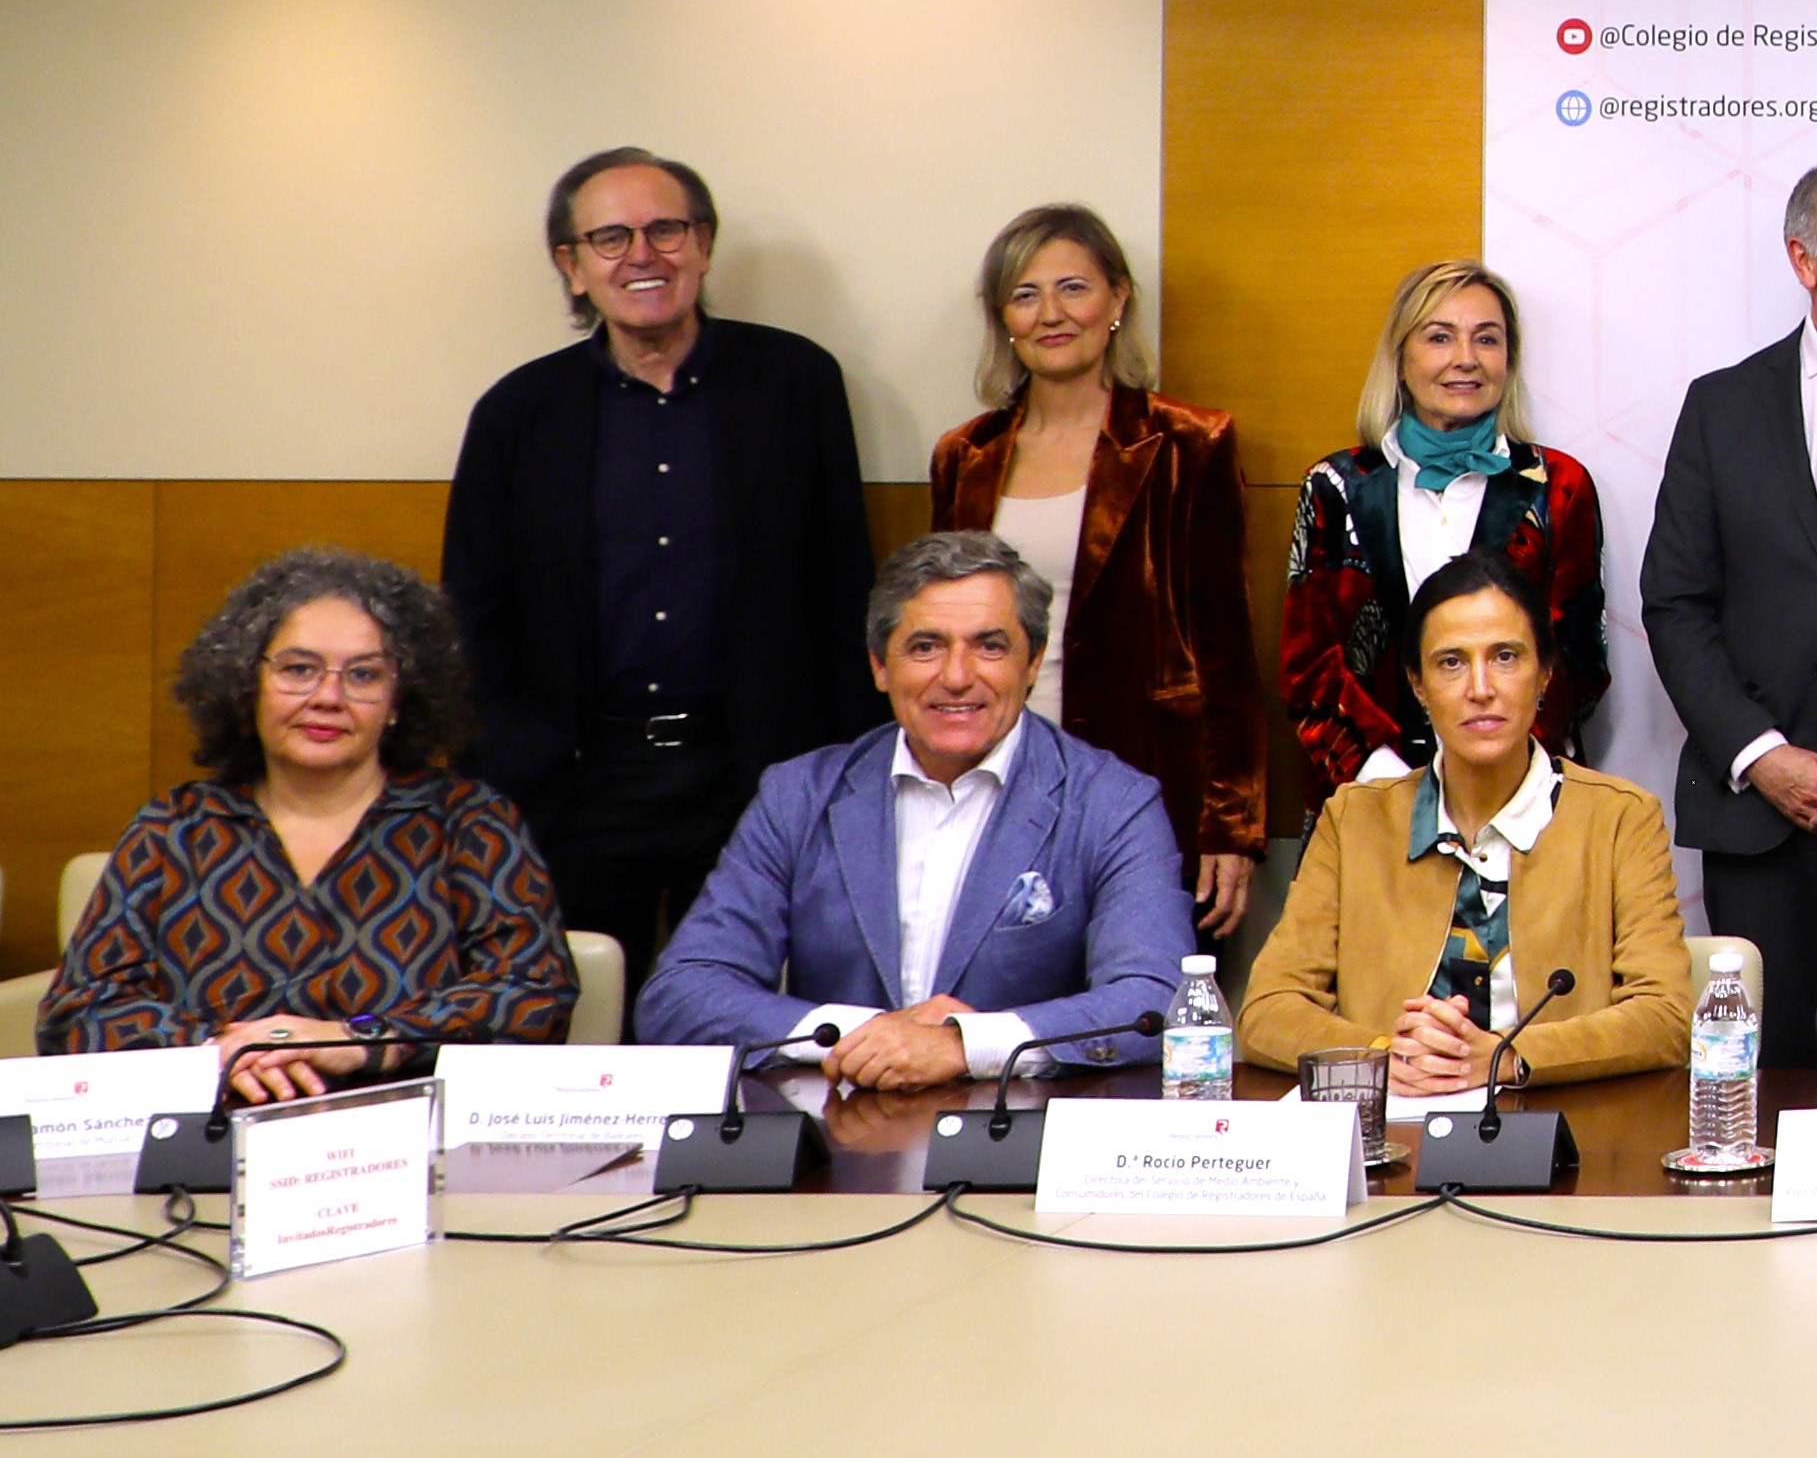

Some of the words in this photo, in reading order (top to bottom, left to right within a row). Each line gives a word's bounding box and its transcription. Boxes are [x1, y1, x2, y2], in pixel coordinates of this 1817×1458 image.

[1600, 24, 1709, 51] @Colegio
[1715, 24, 1745, 48] de
[487, 1112, 519, 1128] José
[525, 1112, 554, 1125] Luis
[326, 1148, 355, 1161] WIFI
[304, 1158, 408, 1184] REGISTRADORES
[1191, 1155, 1271, 1173] Perteguer
[317, 1202, 359, 1219] CLAVE
